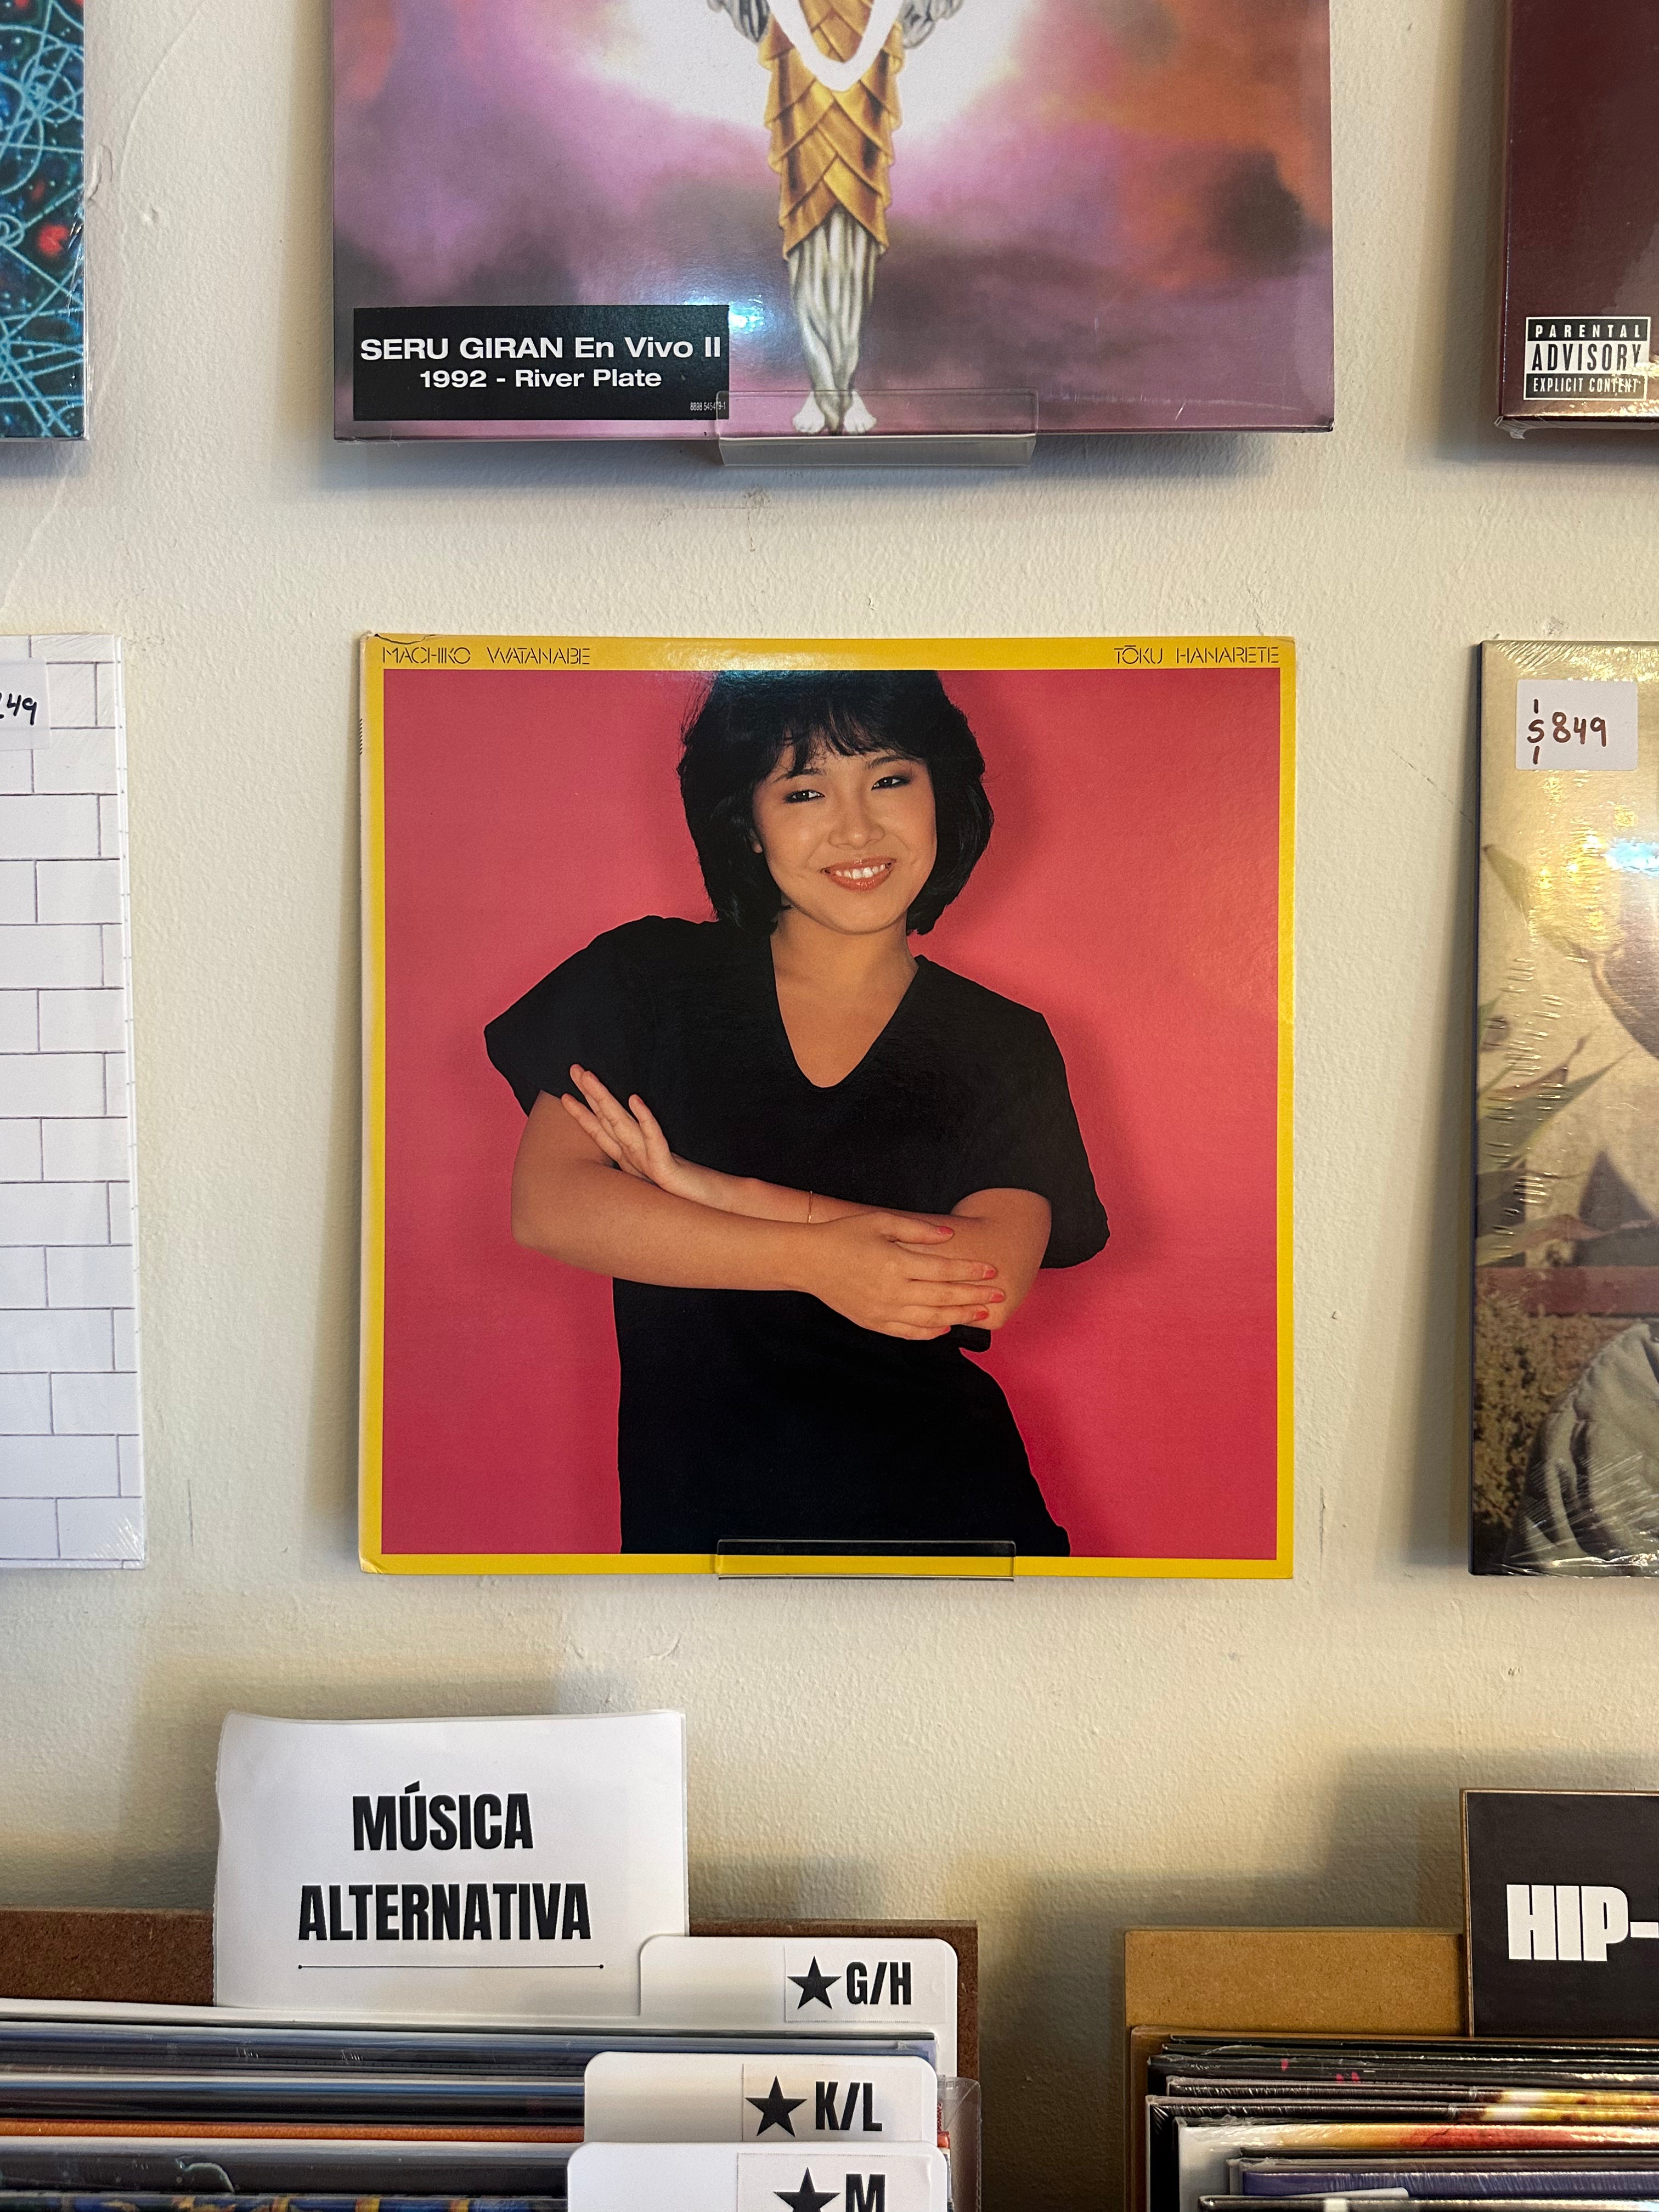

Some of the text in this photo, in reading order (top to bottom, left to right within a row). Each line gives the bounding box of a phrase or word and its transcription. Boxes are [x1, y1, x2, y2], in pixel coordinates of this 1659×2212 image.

[1535, 324, 1640, 338] PARENTAL
[360, 336, 721, 360] SERU GIRAN En Vivo II
[1532, 343, 1641, 371] ADVISORY
[420, 370, 487, 387] 1992
[516, 369, 584, 387] River
[594, 369, 662, 387] Plate
[1533, 377, 1638, 393] EXPLICIT CONTENT
[383, 646, 590, 664] MACHIKO WATANABE
[1114, 645, 1279, 664] TŌKU HANARETE
[353, 1780, 533, 1851] MÚSICA
[298, 1883, 591, 1940] ALTERNATIVA
[847, 1962, 911, 2005] G/H
[815, 2081, 883, 2131] K/L
[845, 2173, 885, 2212] M
